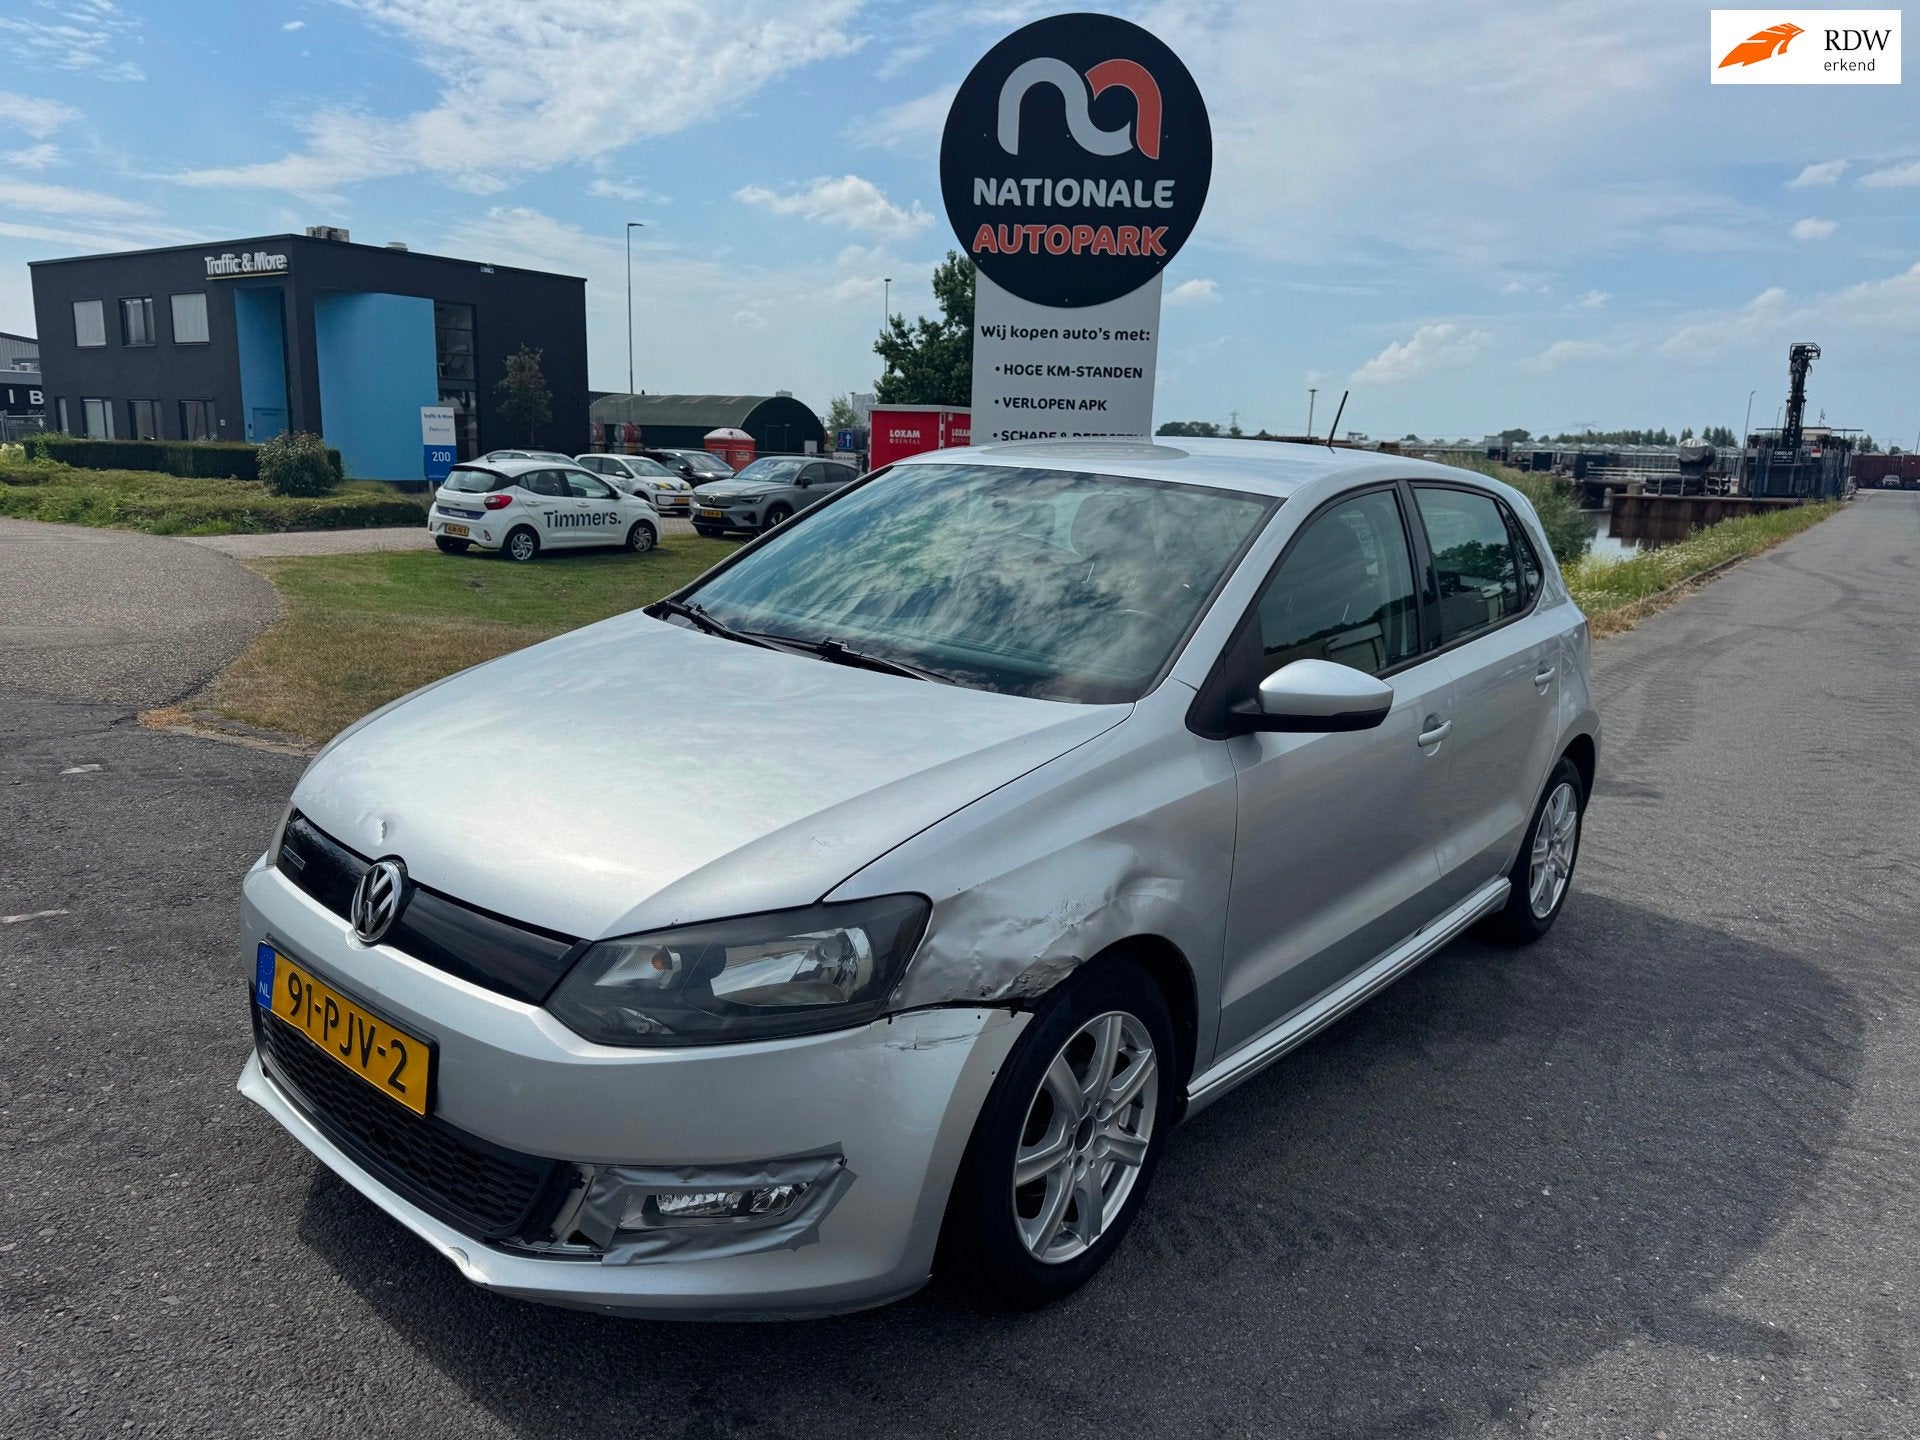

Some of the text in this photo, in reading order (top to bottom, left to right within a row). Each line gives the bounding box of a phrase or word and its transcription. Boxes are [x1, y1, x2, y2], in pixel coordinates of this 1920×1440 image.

[973, 177, 1175, 208] NATIONALE
[972, 223, 1169, 256] AUTOPARK
[204, 251, 288, 275] Traffic & More
[980, 325, 1151, 341] Wij kopen auto's met:
[1003, 364, 1143, 379] HOGE KM-STANDEN
[1002, 396, 1108, 411] VERLOPEN APK
[889, 429, 920, 438] LOXAM
[431, 451, 451, 462] 200
[543, 509, 622, 528] Timmers.
[259, 980, 270, 999] NL
[287, 970, 408, 1095] 91-PJV-2
